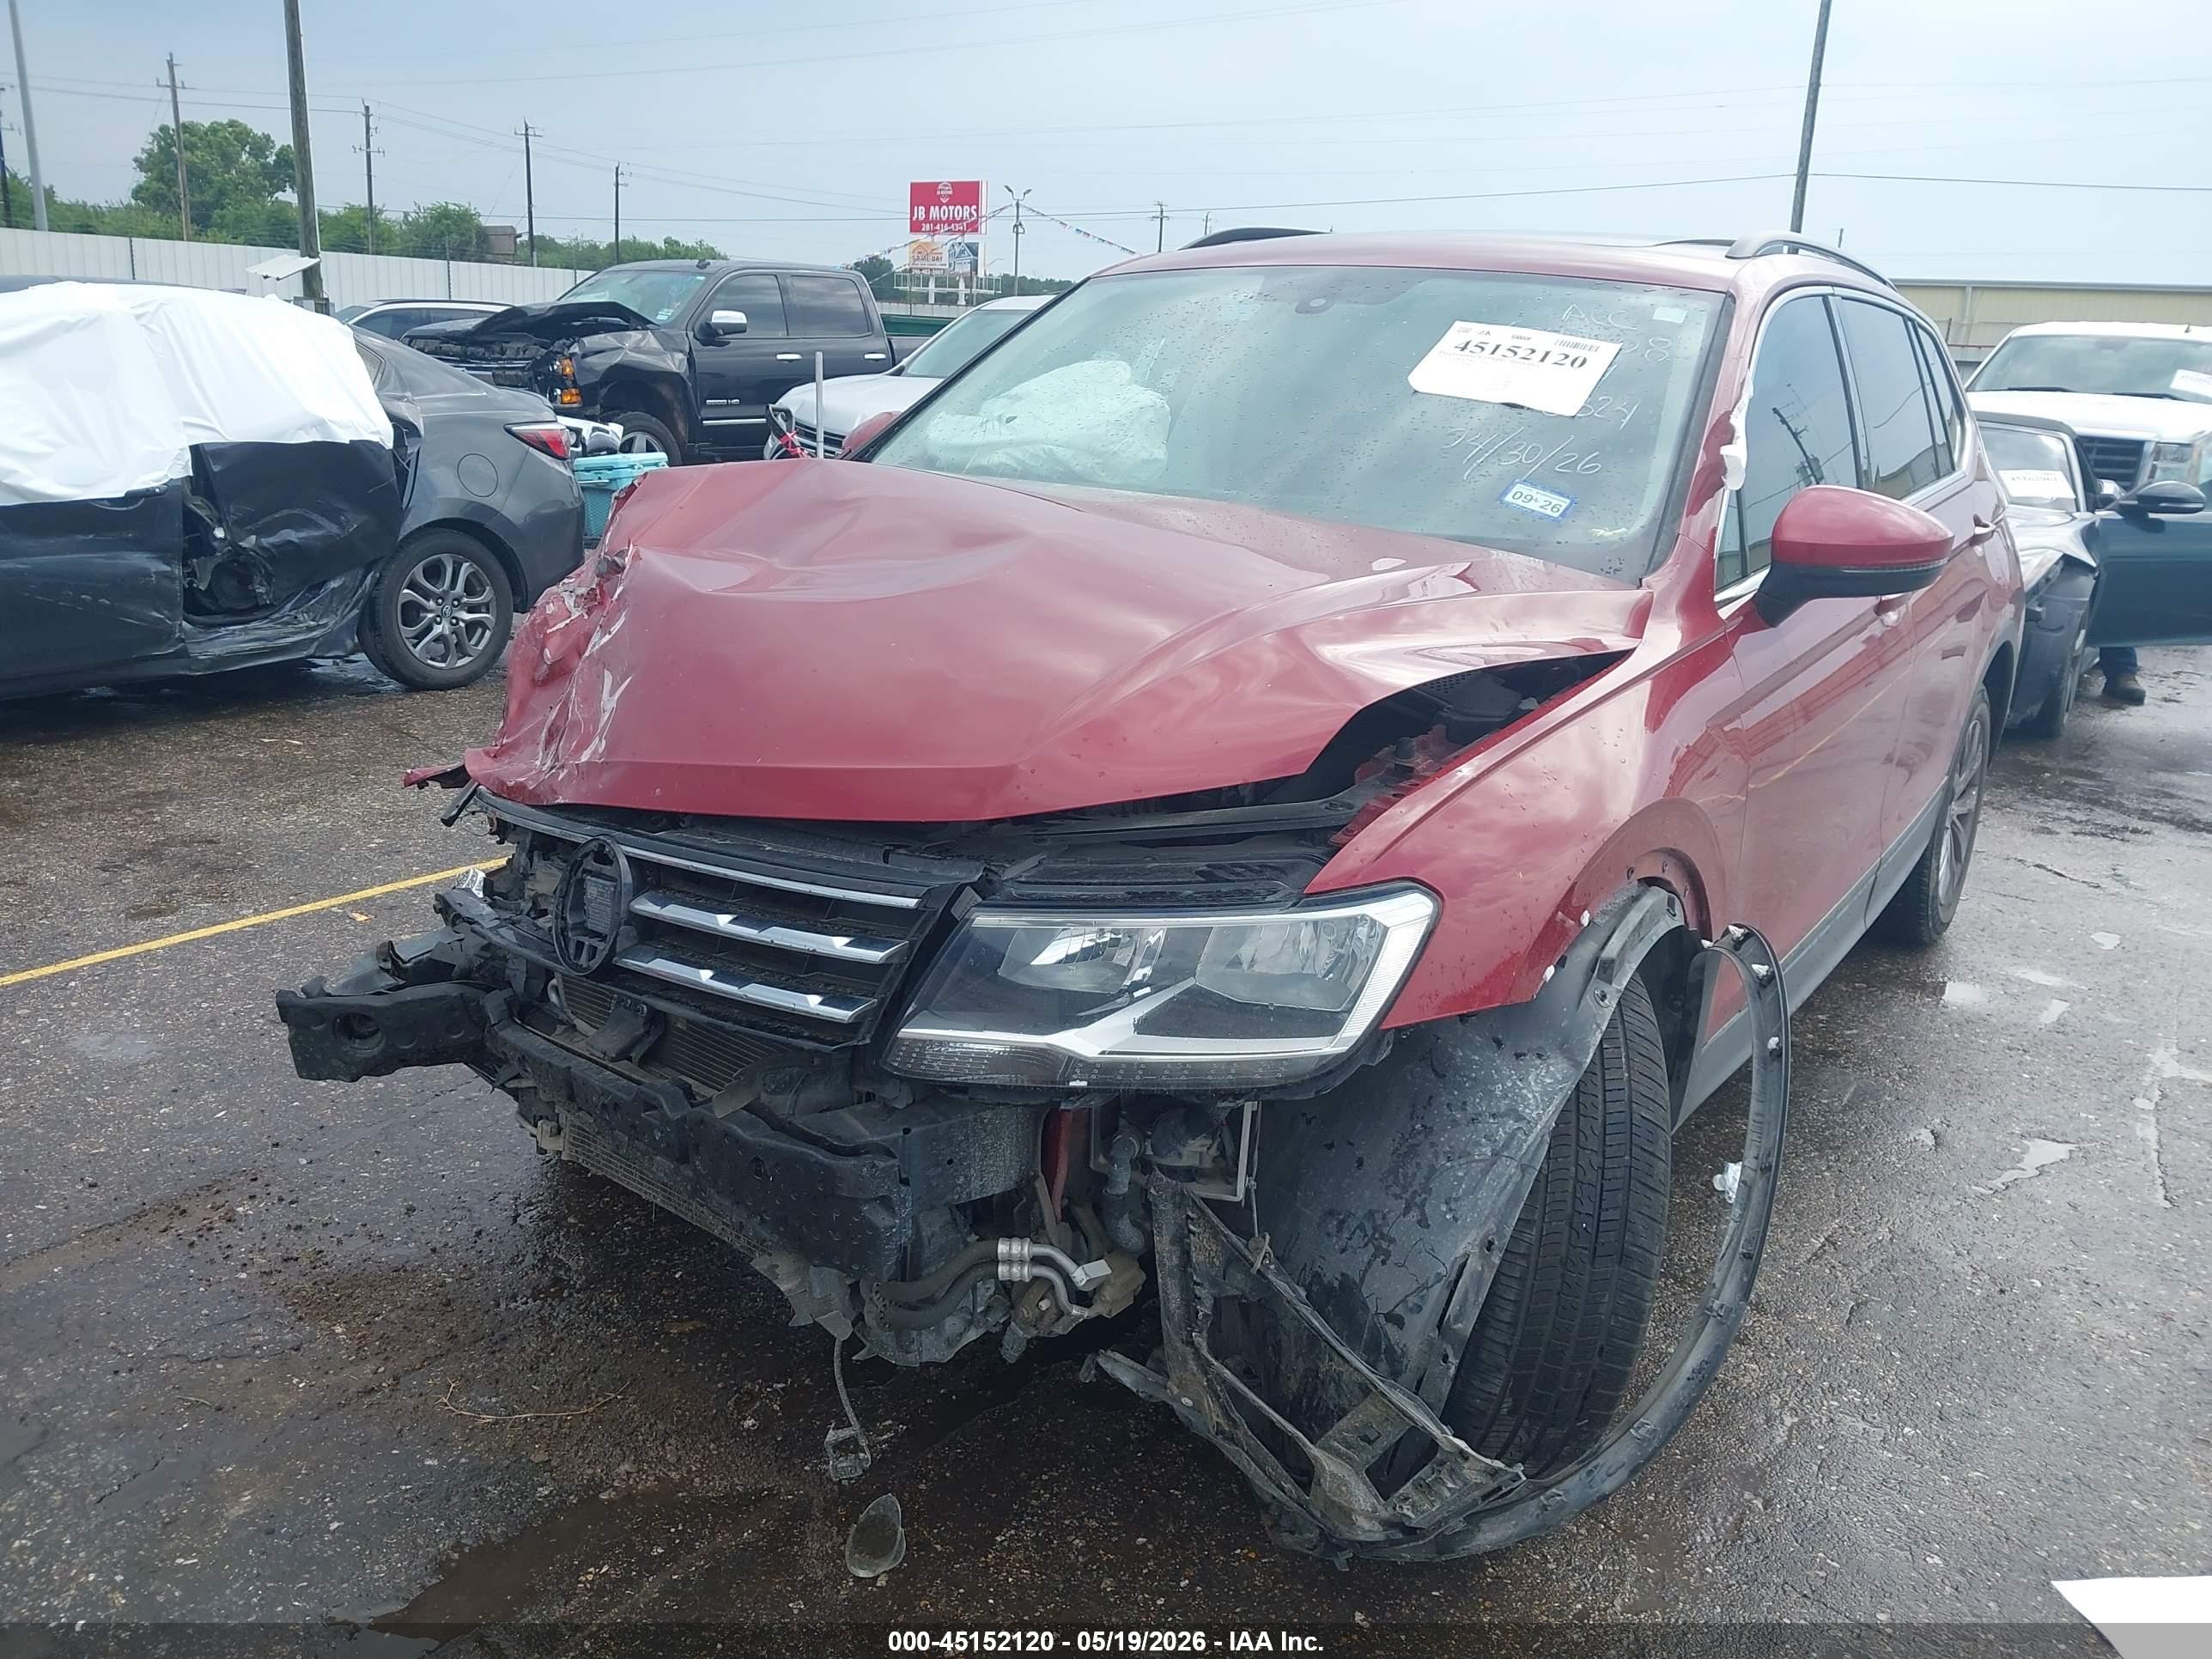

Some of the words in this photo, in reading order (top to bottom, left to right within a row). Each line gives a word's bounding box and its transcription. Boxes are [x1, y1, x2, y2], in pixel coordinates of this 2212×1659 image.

[913, 205, 926, 221] JB
[929, 205, 977, 221] MOTORS
[1454, 339, 1588, 369] 45152120
[1511, 490, 1534, 503] 09
[1538, 500, 1563, 514] 26
